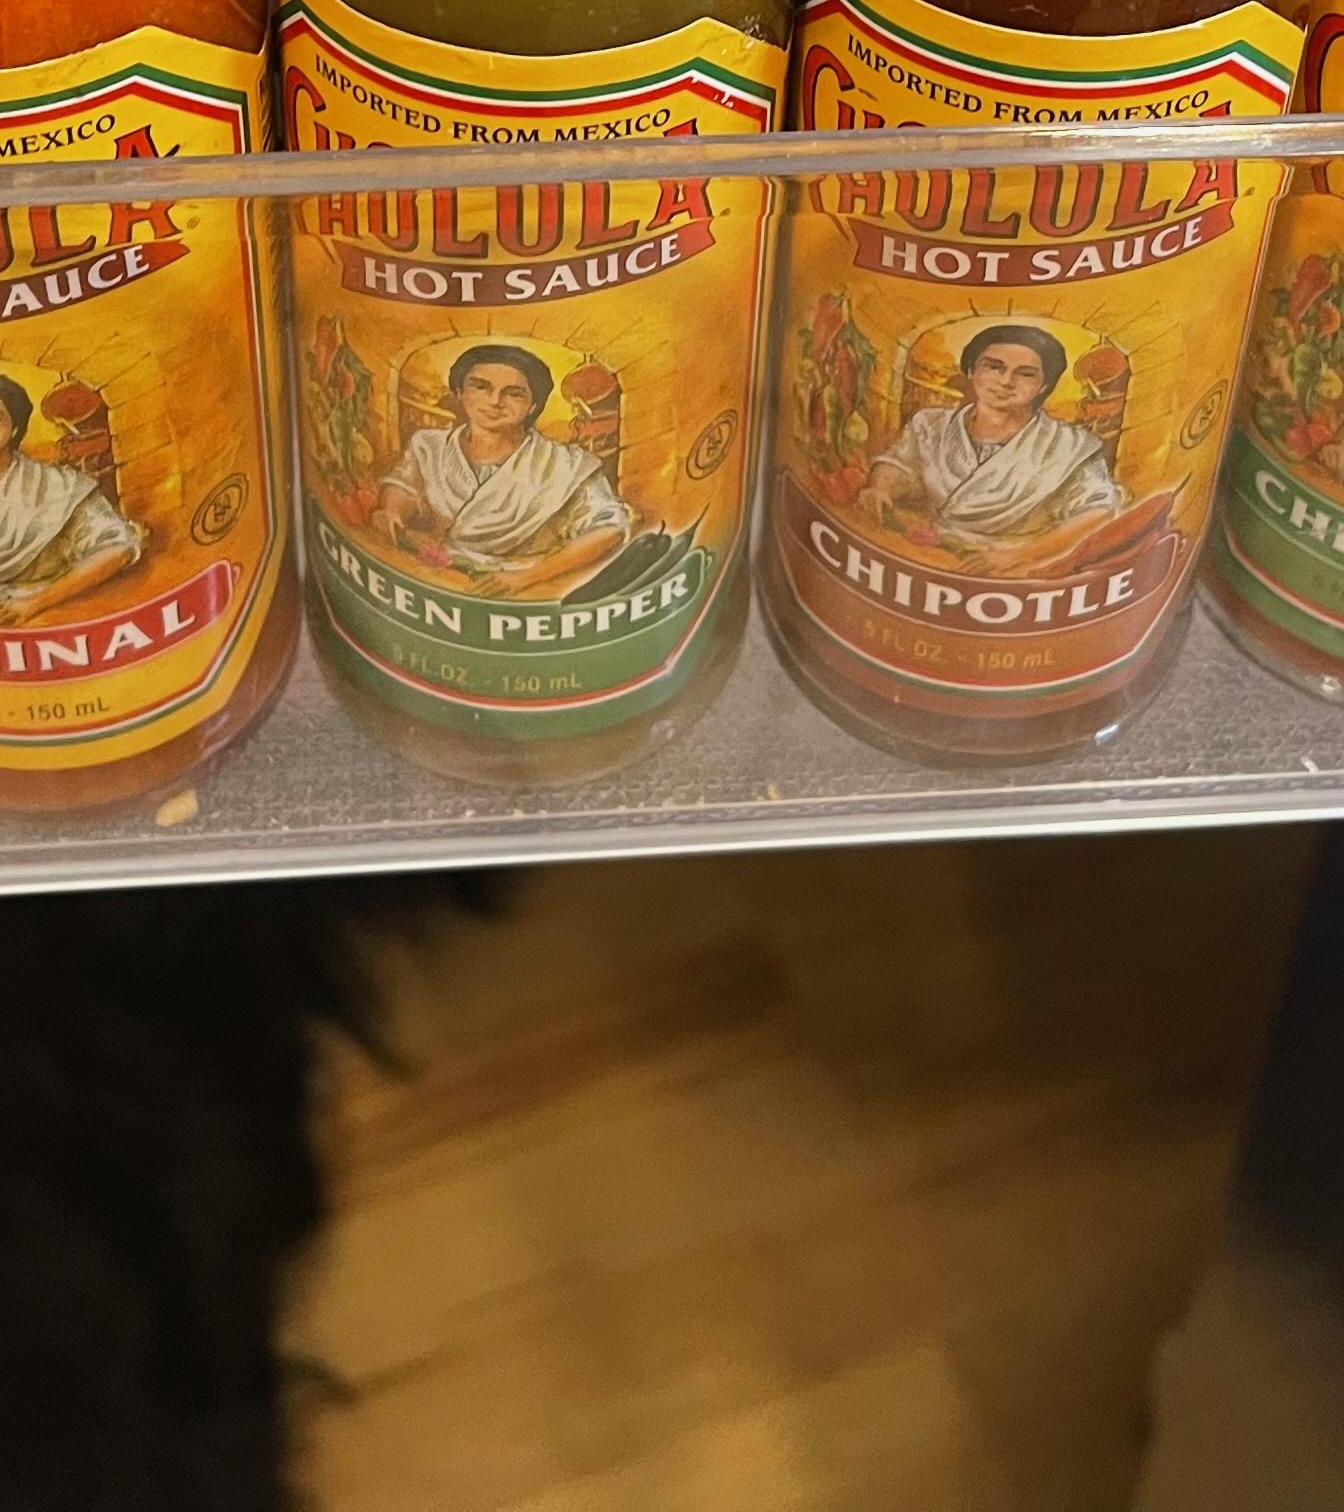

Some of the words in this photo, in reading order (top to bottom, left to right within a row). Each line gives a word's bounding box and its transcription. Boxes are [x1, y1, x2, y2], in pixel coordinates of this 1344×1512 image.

[315, 54, 441, 133] IMPORTED
[453, 121, 540, 143] FROM
[555, 108, 672, 141] MEXICO
[847, 33, 982, 113] IMPORTED
[993, 101, 1082, 124] FROM
[1096, 90, 1210, 121] MEXICO
[364, 258, 483, 303] HOT
[504, 233, 682, 298] SAUCE
[881, 235, 1010, 283] HOT
[1029, 215, 1203, 281] SAUCE
[318, 522, 462, 635] GREEN
[488, 571, 690, 642] PEPPER
[809, 520, 1136, 623] CHIPOTLE
[502, 676, 541, 692] 150
[978, 652, 1015, 669] 150
[26, 704, 66, 721] 150
[76, 697, 110, 717] mL
